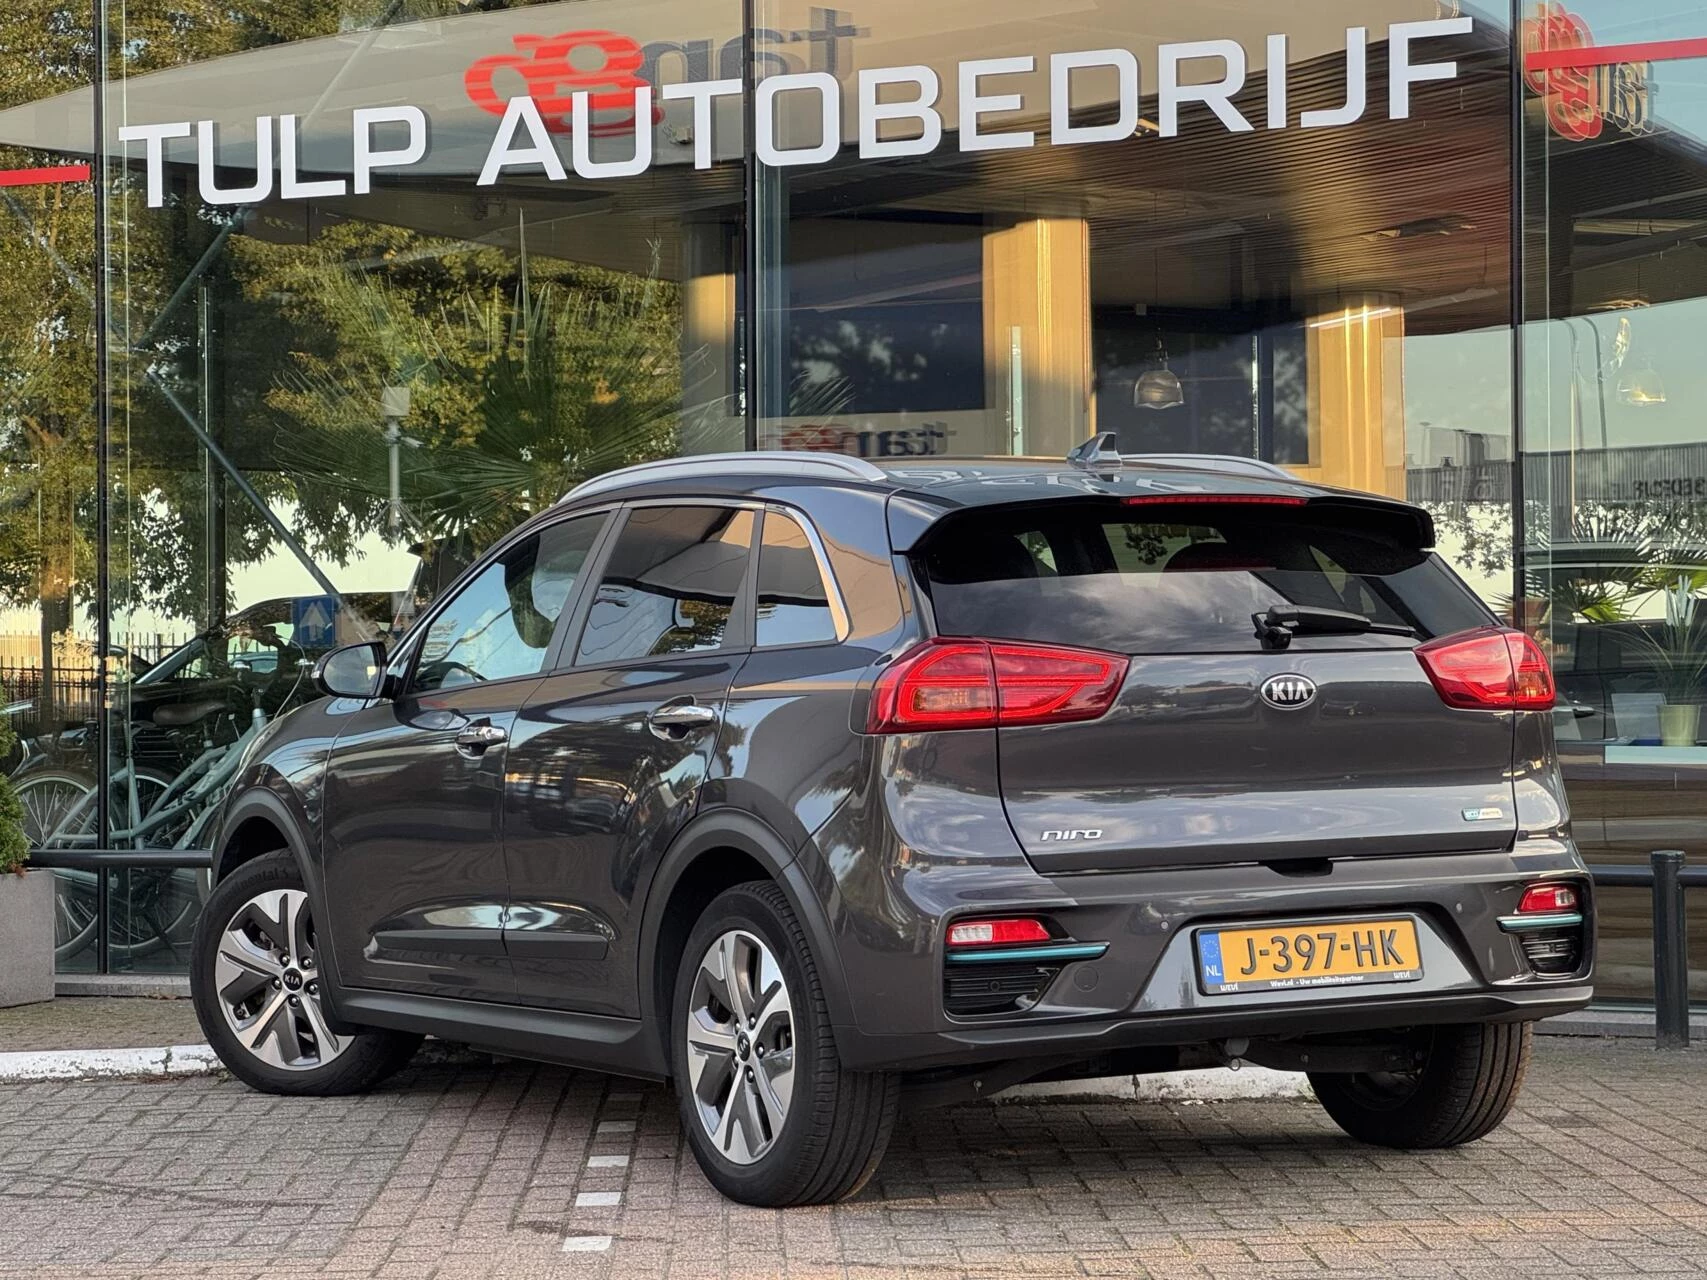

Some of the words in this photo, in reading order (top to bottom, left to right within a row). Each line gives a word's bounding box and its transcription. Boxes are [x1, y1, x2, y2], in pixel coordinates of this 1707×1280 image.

[118, 105, 427, 208] TULP
[476, 16, 1473, 187] AUTOBEDRIJF
[1271, 681, 1308, 701] KIA
[1041, 829, 1103, 841] niro
[1241, 929, 1404, 975] J-397-HK
[1206, 965, 1222, 977] NL
[284, 974, 301, 986] KIA
[1300, 977, 1311, 986] Uw
